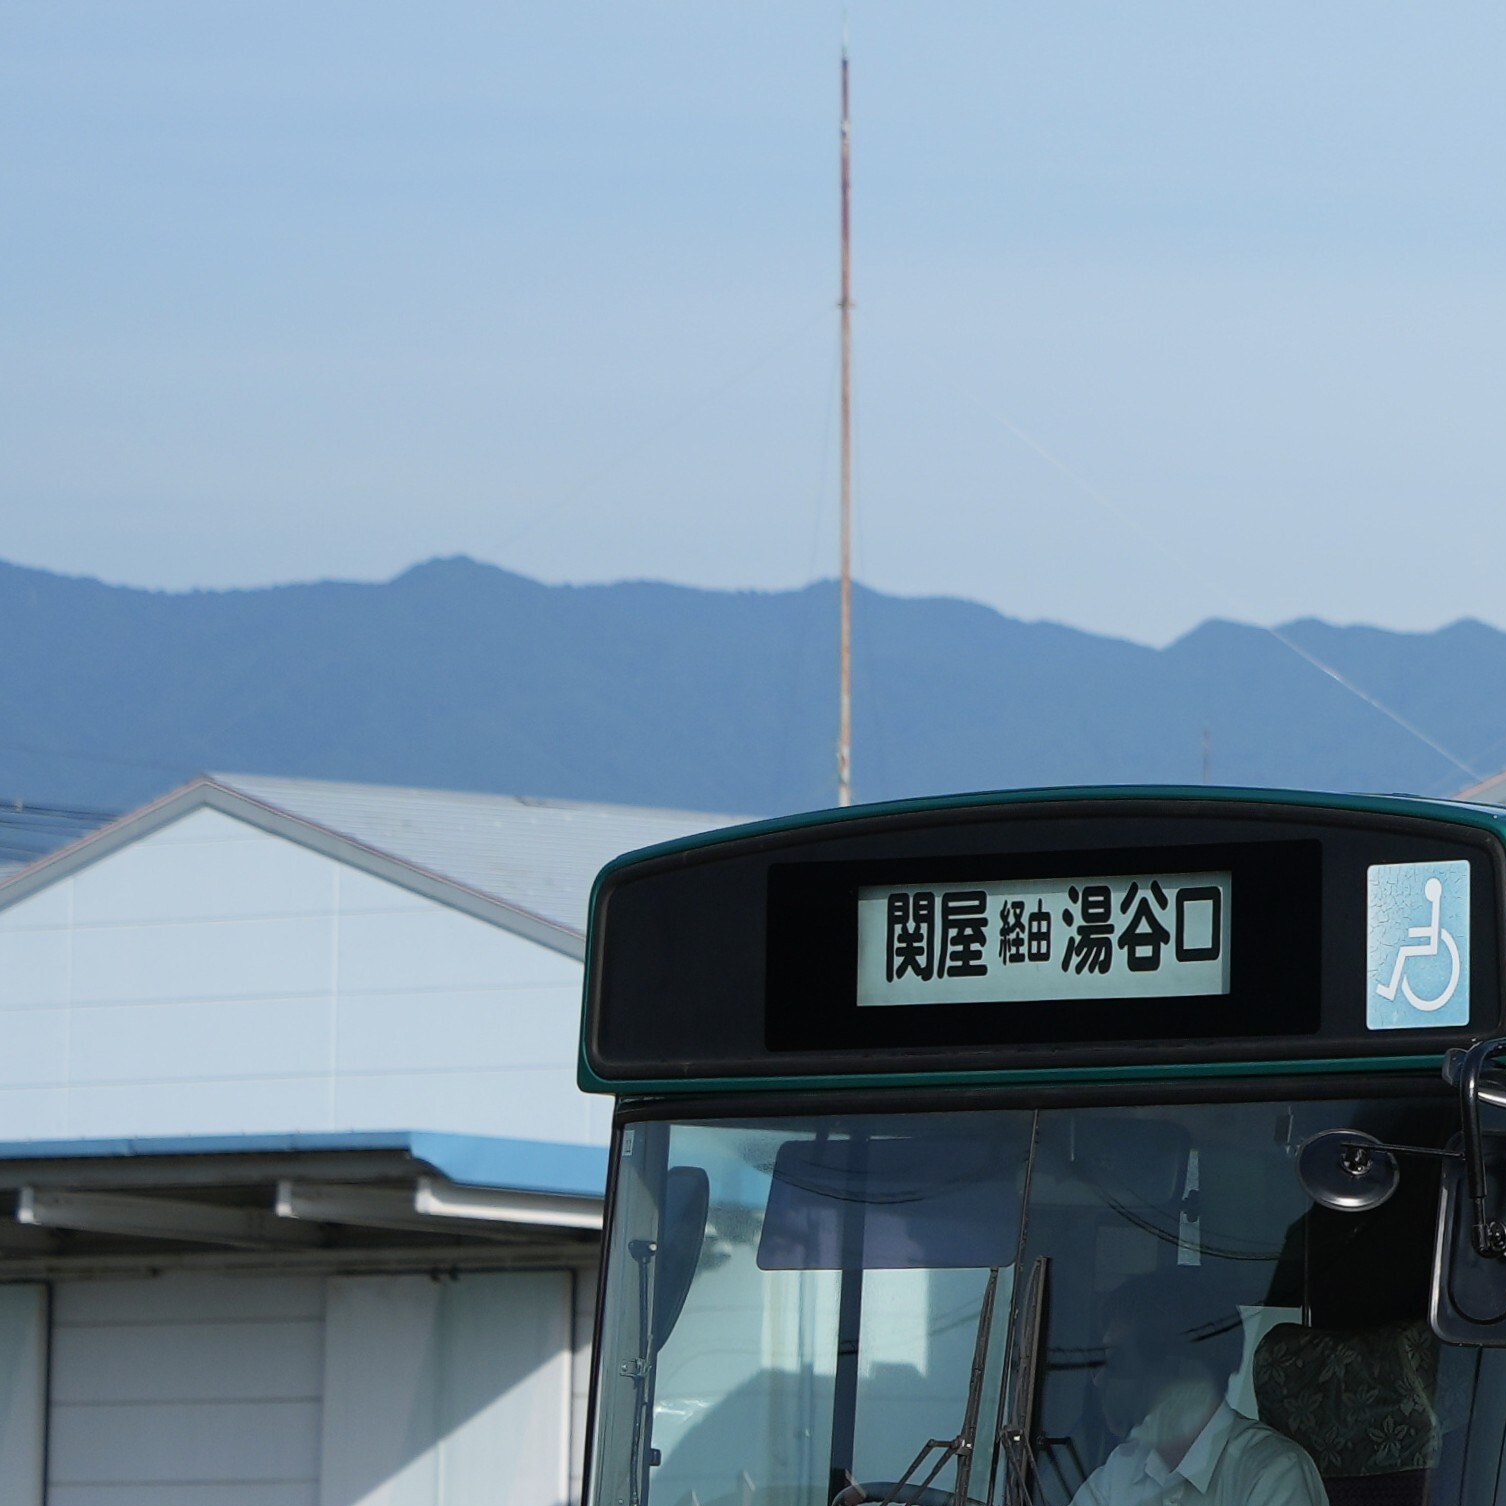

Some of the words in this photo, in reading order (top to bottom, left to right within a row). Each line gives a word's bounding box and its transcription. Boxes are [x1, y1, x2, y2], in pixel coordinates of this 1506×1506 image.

[885, 880, 1222, 983] 関屋経由湯谷口
